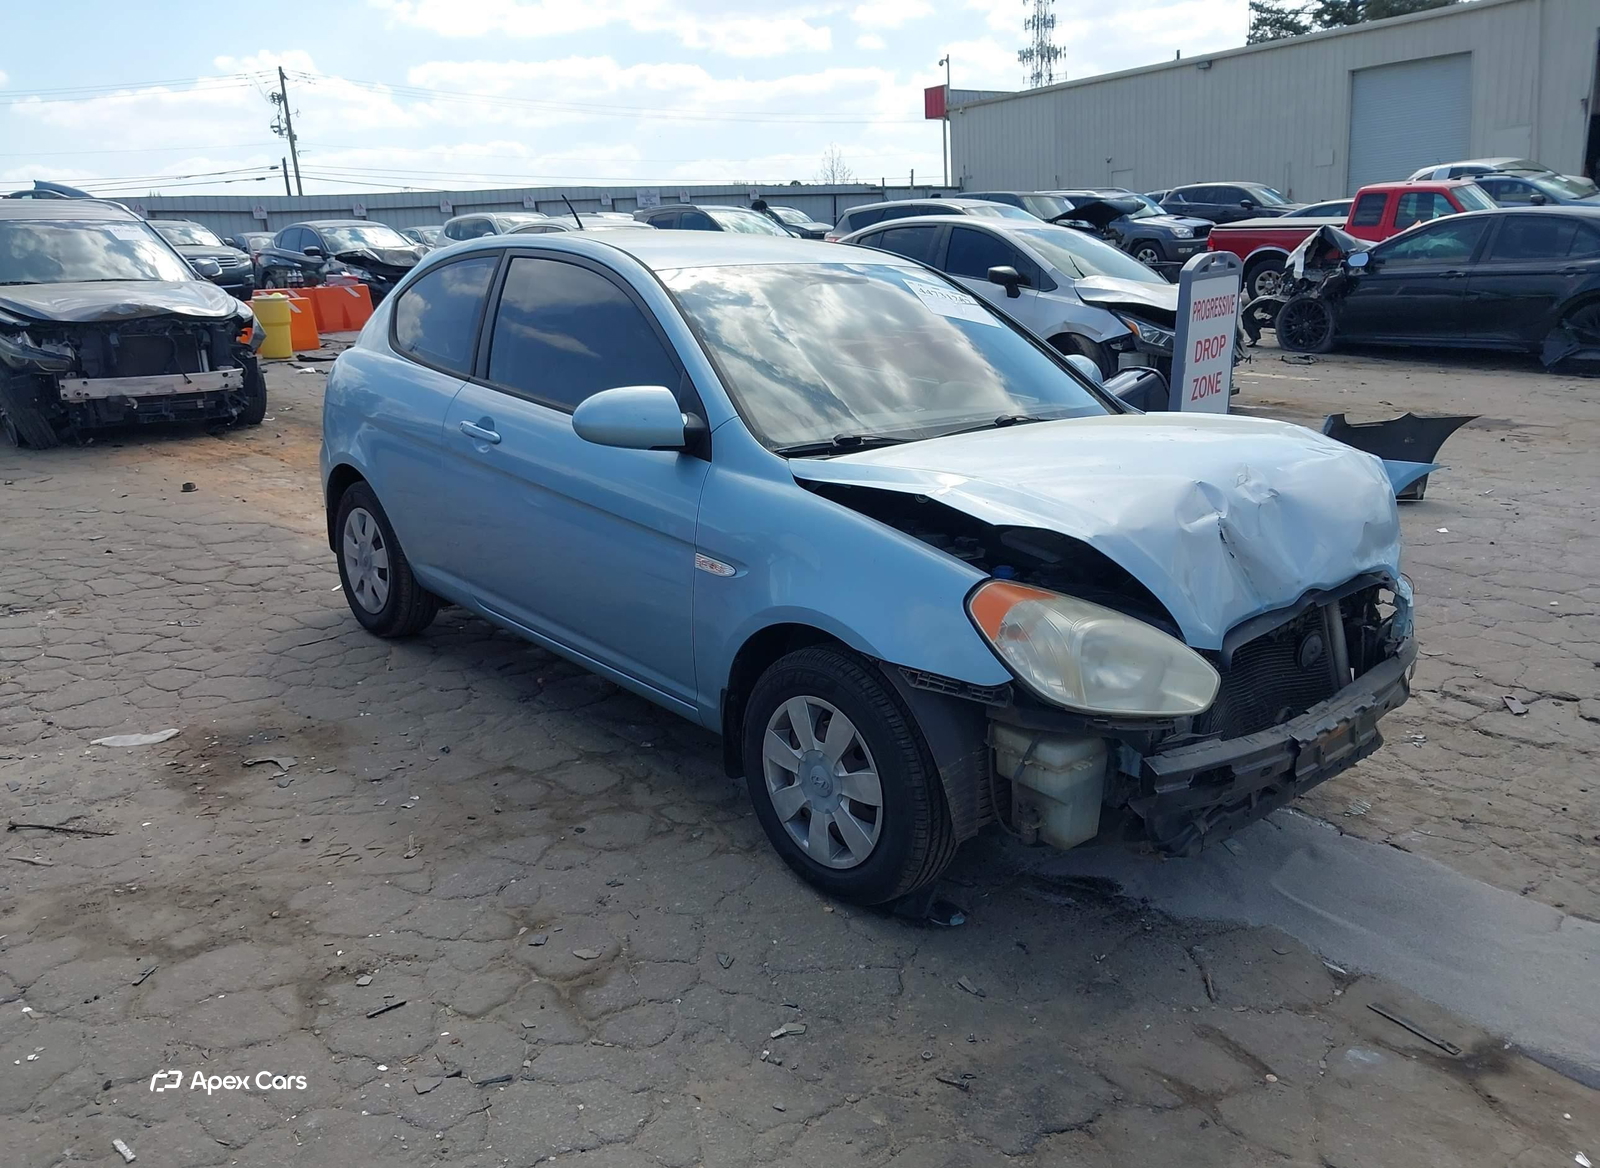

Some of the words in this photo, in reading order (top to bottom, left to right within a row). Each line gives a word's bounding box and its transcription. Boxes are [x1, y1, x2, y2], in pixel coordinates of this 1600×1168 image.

[1192, 294, 1236, 322] PROGRESSIVE
[1194, 334, 1227, 363] DROP
[1191, 371, 1223, 401] ZONE
